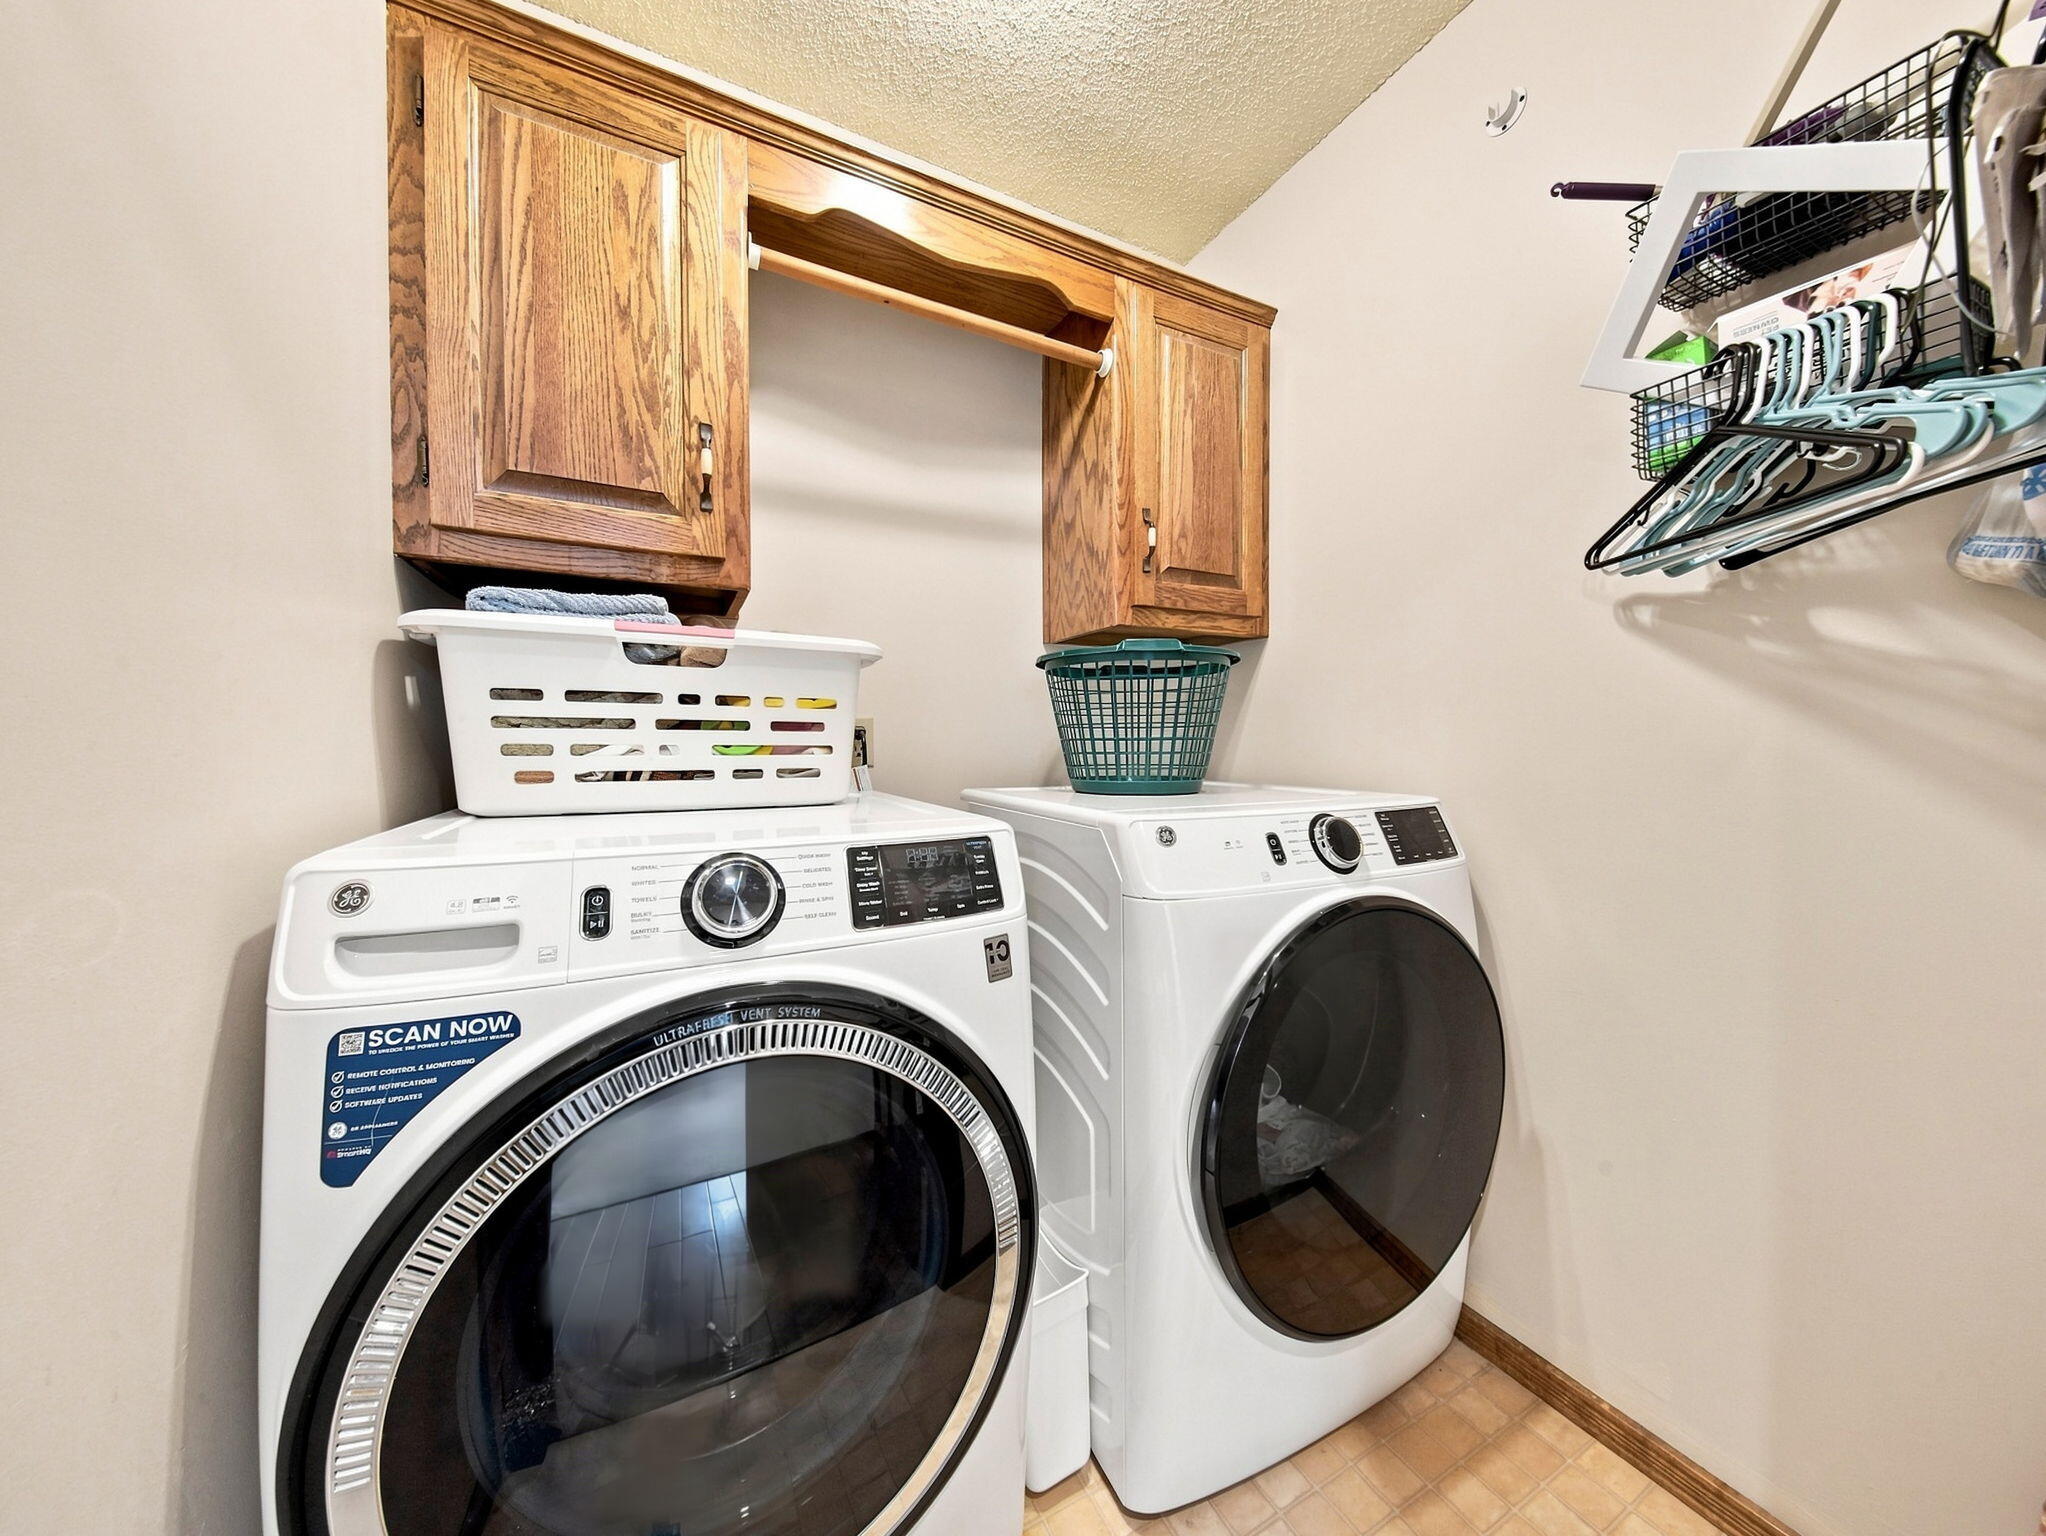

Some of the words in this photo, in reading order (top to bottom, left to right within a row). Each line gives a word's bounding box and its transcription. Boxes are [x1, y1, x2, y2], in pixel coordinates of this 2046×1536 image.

[630, 927, 659, 935] SANITIZE
[985, 940, 1010, 965] 10
[368, 1023, 441, 1048] SCAN
[450, 1015, 513, 1038] NOW
[653, 1012, 734, 1047] ULTRAFRESH
[740, 1008, 772, 1022] VENT
[777, 1007, 821, 1018] SYSTEM
[417, 1042, 439, 1050] POWER
[450, 1038, 467, 1046] YOUR
[347, 1069, 378, 1080] REMOTE
[379, 1066, 417, 1076] CONTROL
[425, 1057, 475, 1070] MONITORING
[345, 1085, 377, 1095] RECEIVE
[378, 1077, 437, 1090] NOTIFICATIONS
[344, 1098, 386, 1109] SOFTWARE
[388, 1093, 423, 1104] UPDATES
